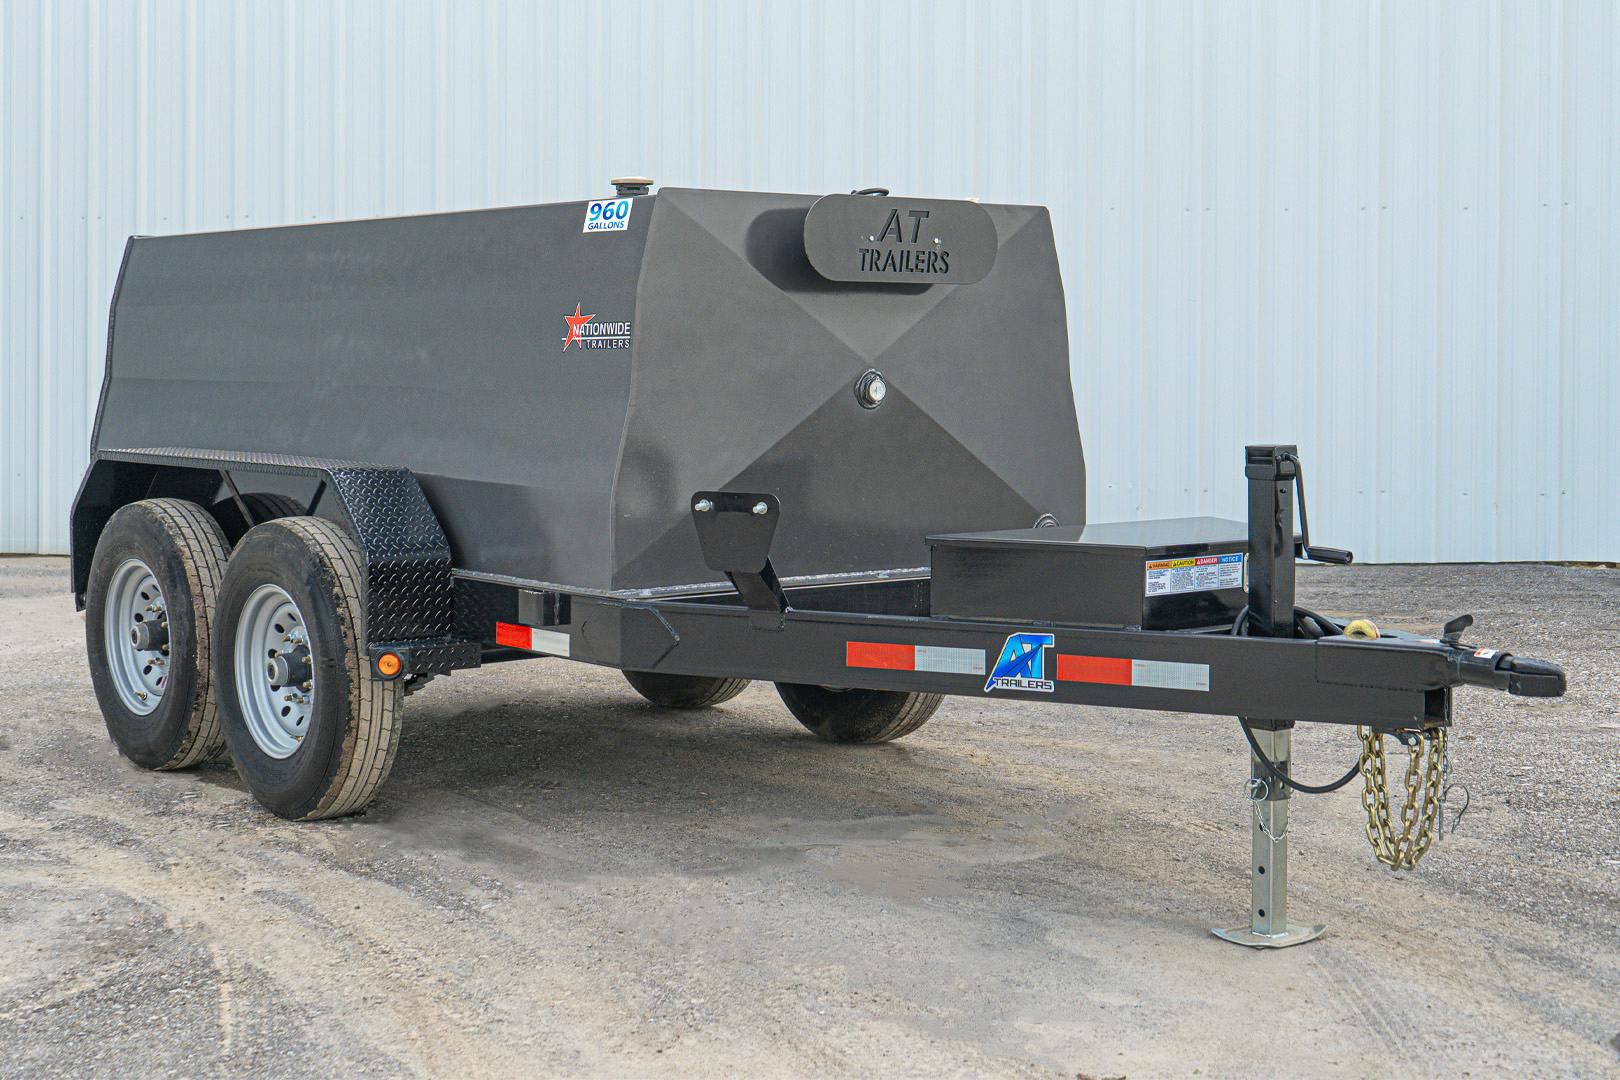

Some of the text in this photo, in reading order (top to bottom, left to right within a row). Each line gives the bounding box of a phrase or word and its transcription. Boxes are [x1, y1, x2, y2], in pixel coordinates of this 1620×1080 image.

[589, 201, 629, 221] 960
[588, 221, 625, 230] GALLONS
[877, 209, 930, 243] AT
[859, 248, 950, 274] TRAILERS
[573, 322, 631, 336] NATIONWIDE
[587, 339, 630, 349] TRAILERS
[987, 634, 1053, 681] AT
[994, 678, 1053, 690] TRAILERS
